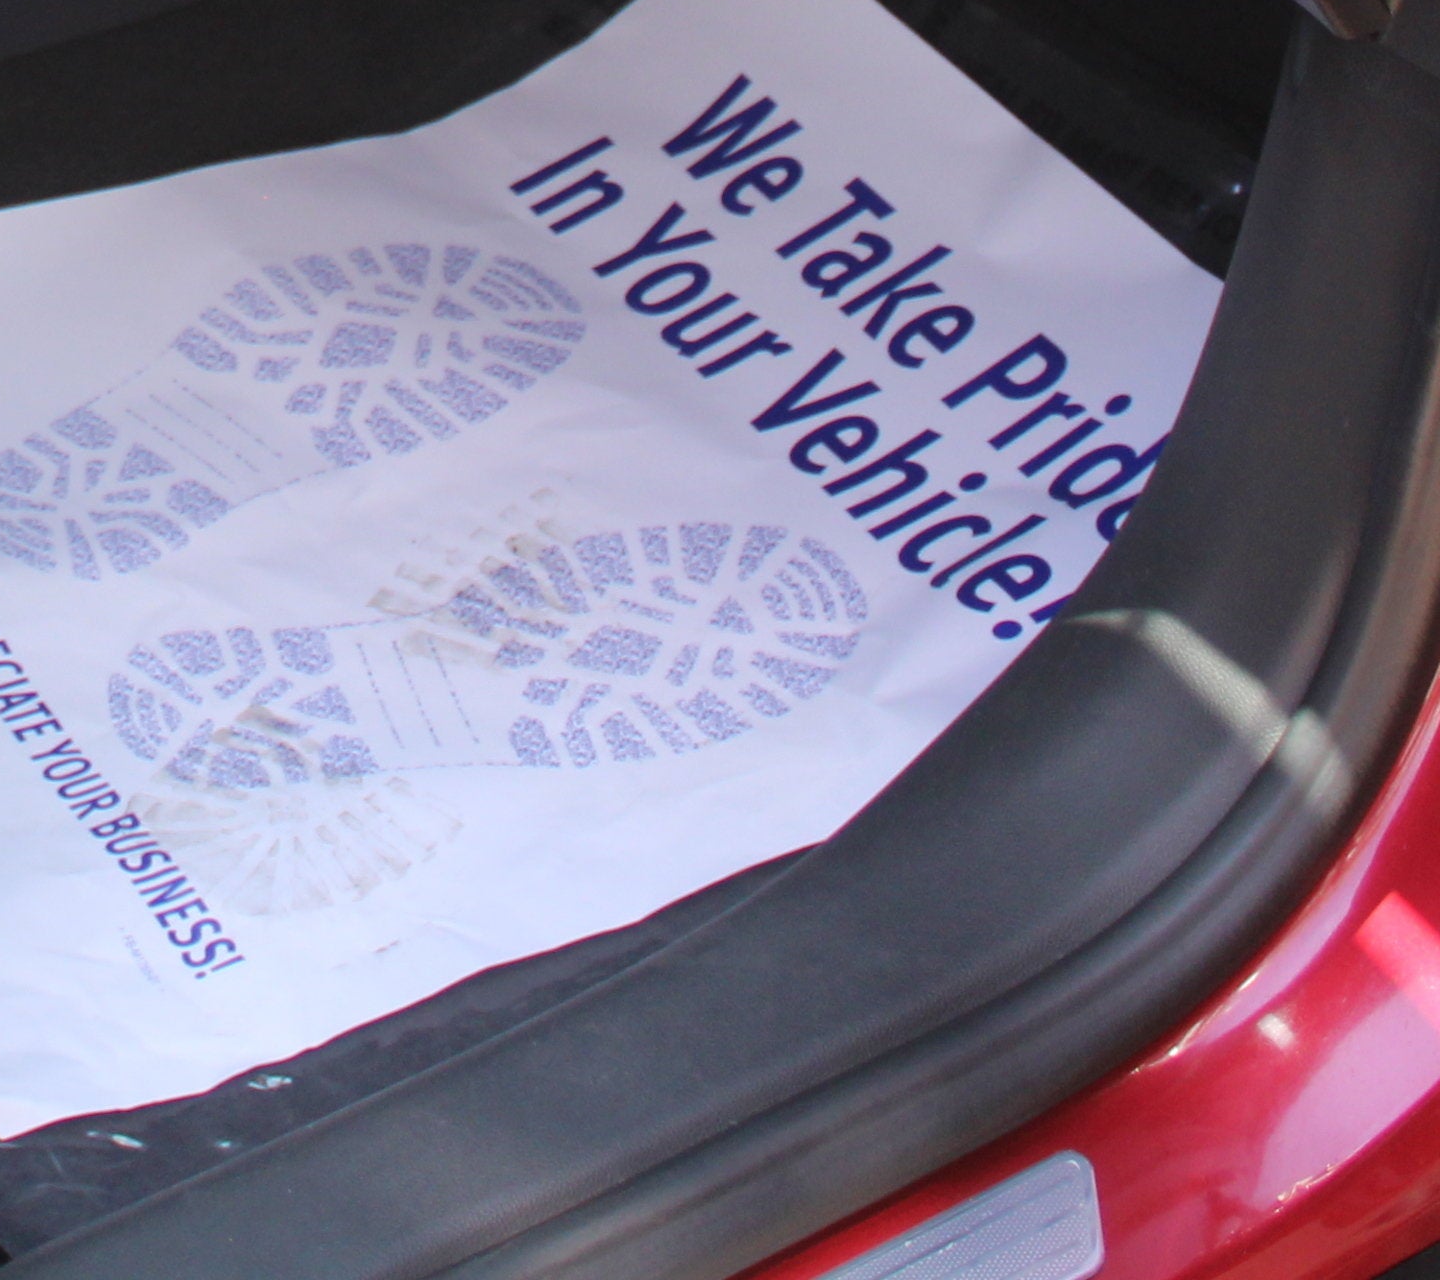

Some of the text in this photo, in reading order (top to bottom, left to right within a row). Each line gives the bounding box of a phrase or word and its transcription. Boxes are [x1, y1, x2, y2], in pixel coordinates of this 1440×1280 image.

[509, 136, 625, 235] In
[591, 202, 794, 379] Your
[662, 73, 803, 216] We
[775, 177, 976, 370] Take
[31, 738, 122, 821] YOUR
[90, 813, 246, 980] BUSINESS!
